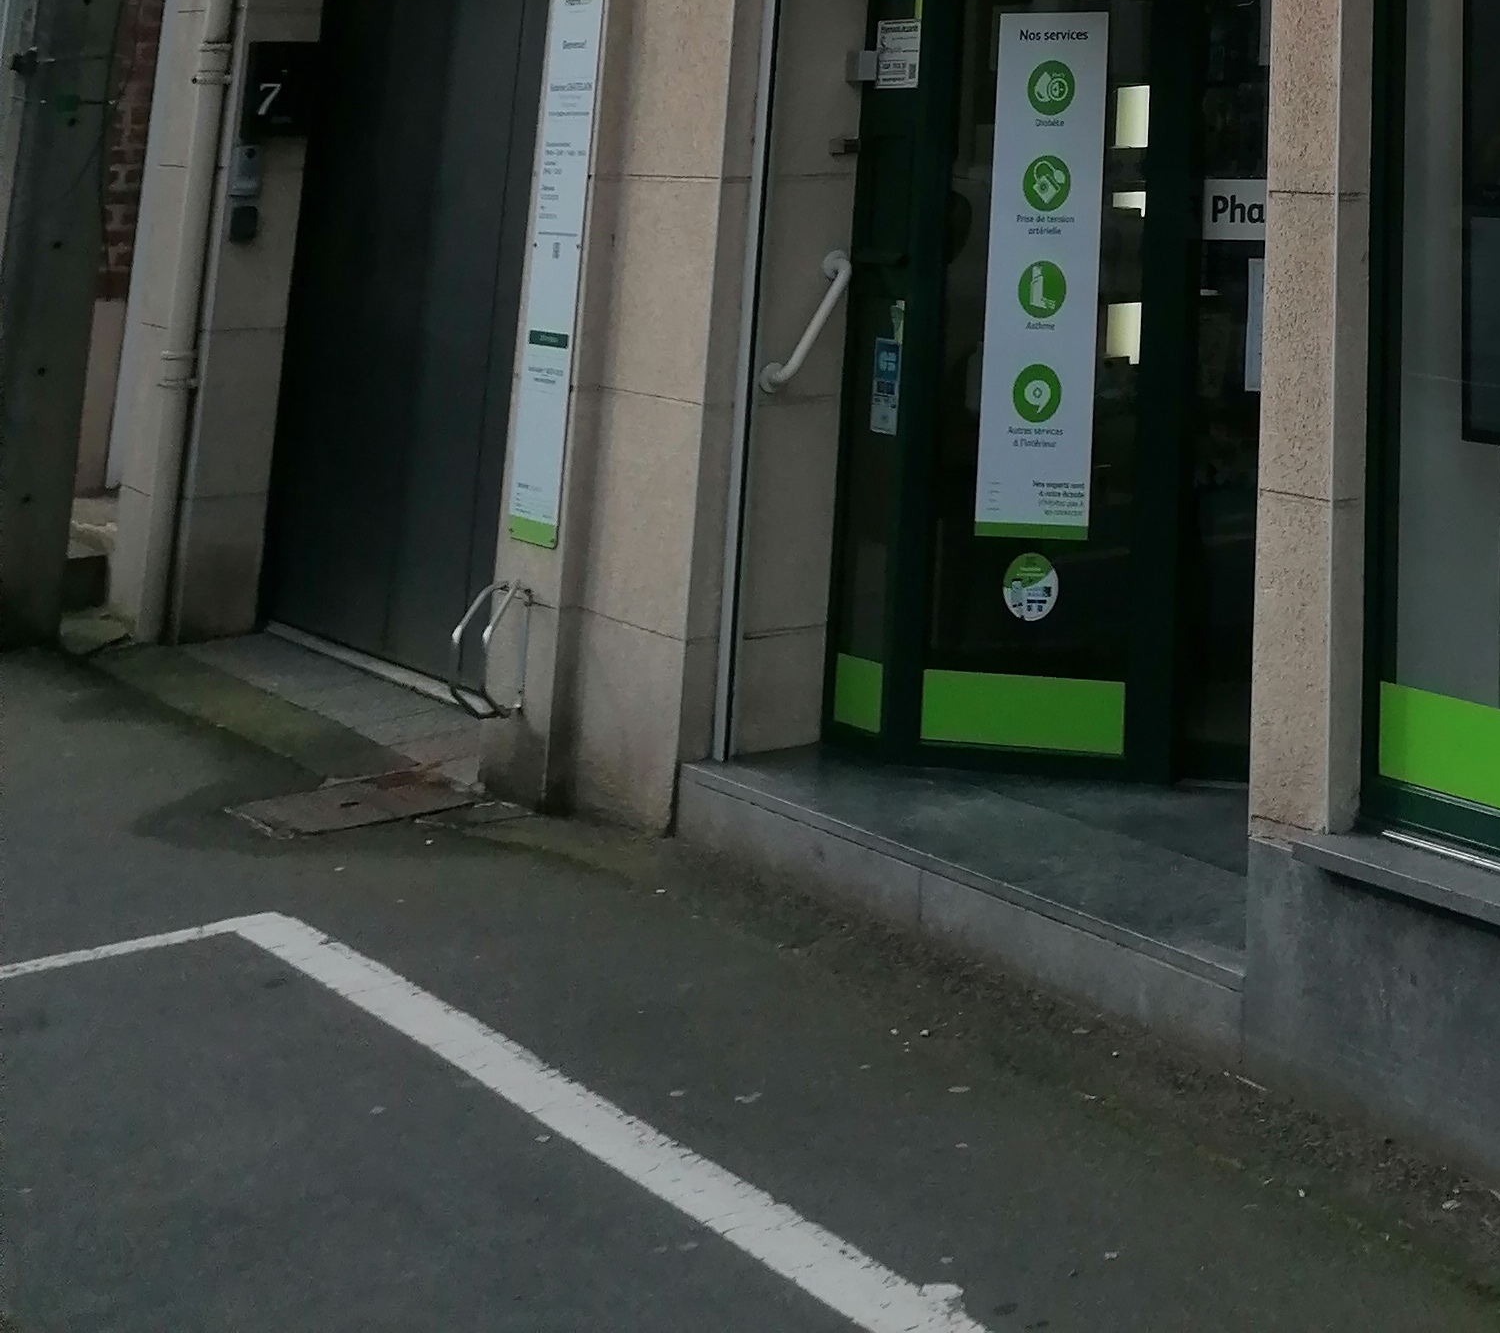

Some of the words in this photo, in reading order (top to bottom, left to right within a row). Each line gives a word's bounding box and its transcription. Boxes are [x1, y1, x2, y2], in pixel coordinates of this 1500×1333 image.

[1019, 29, 1041, 41] Nos
[1044, 29, 1089, 41] services
[257, 83, 282, 116] 7
[1211, 194, 1265, 224] Pha
